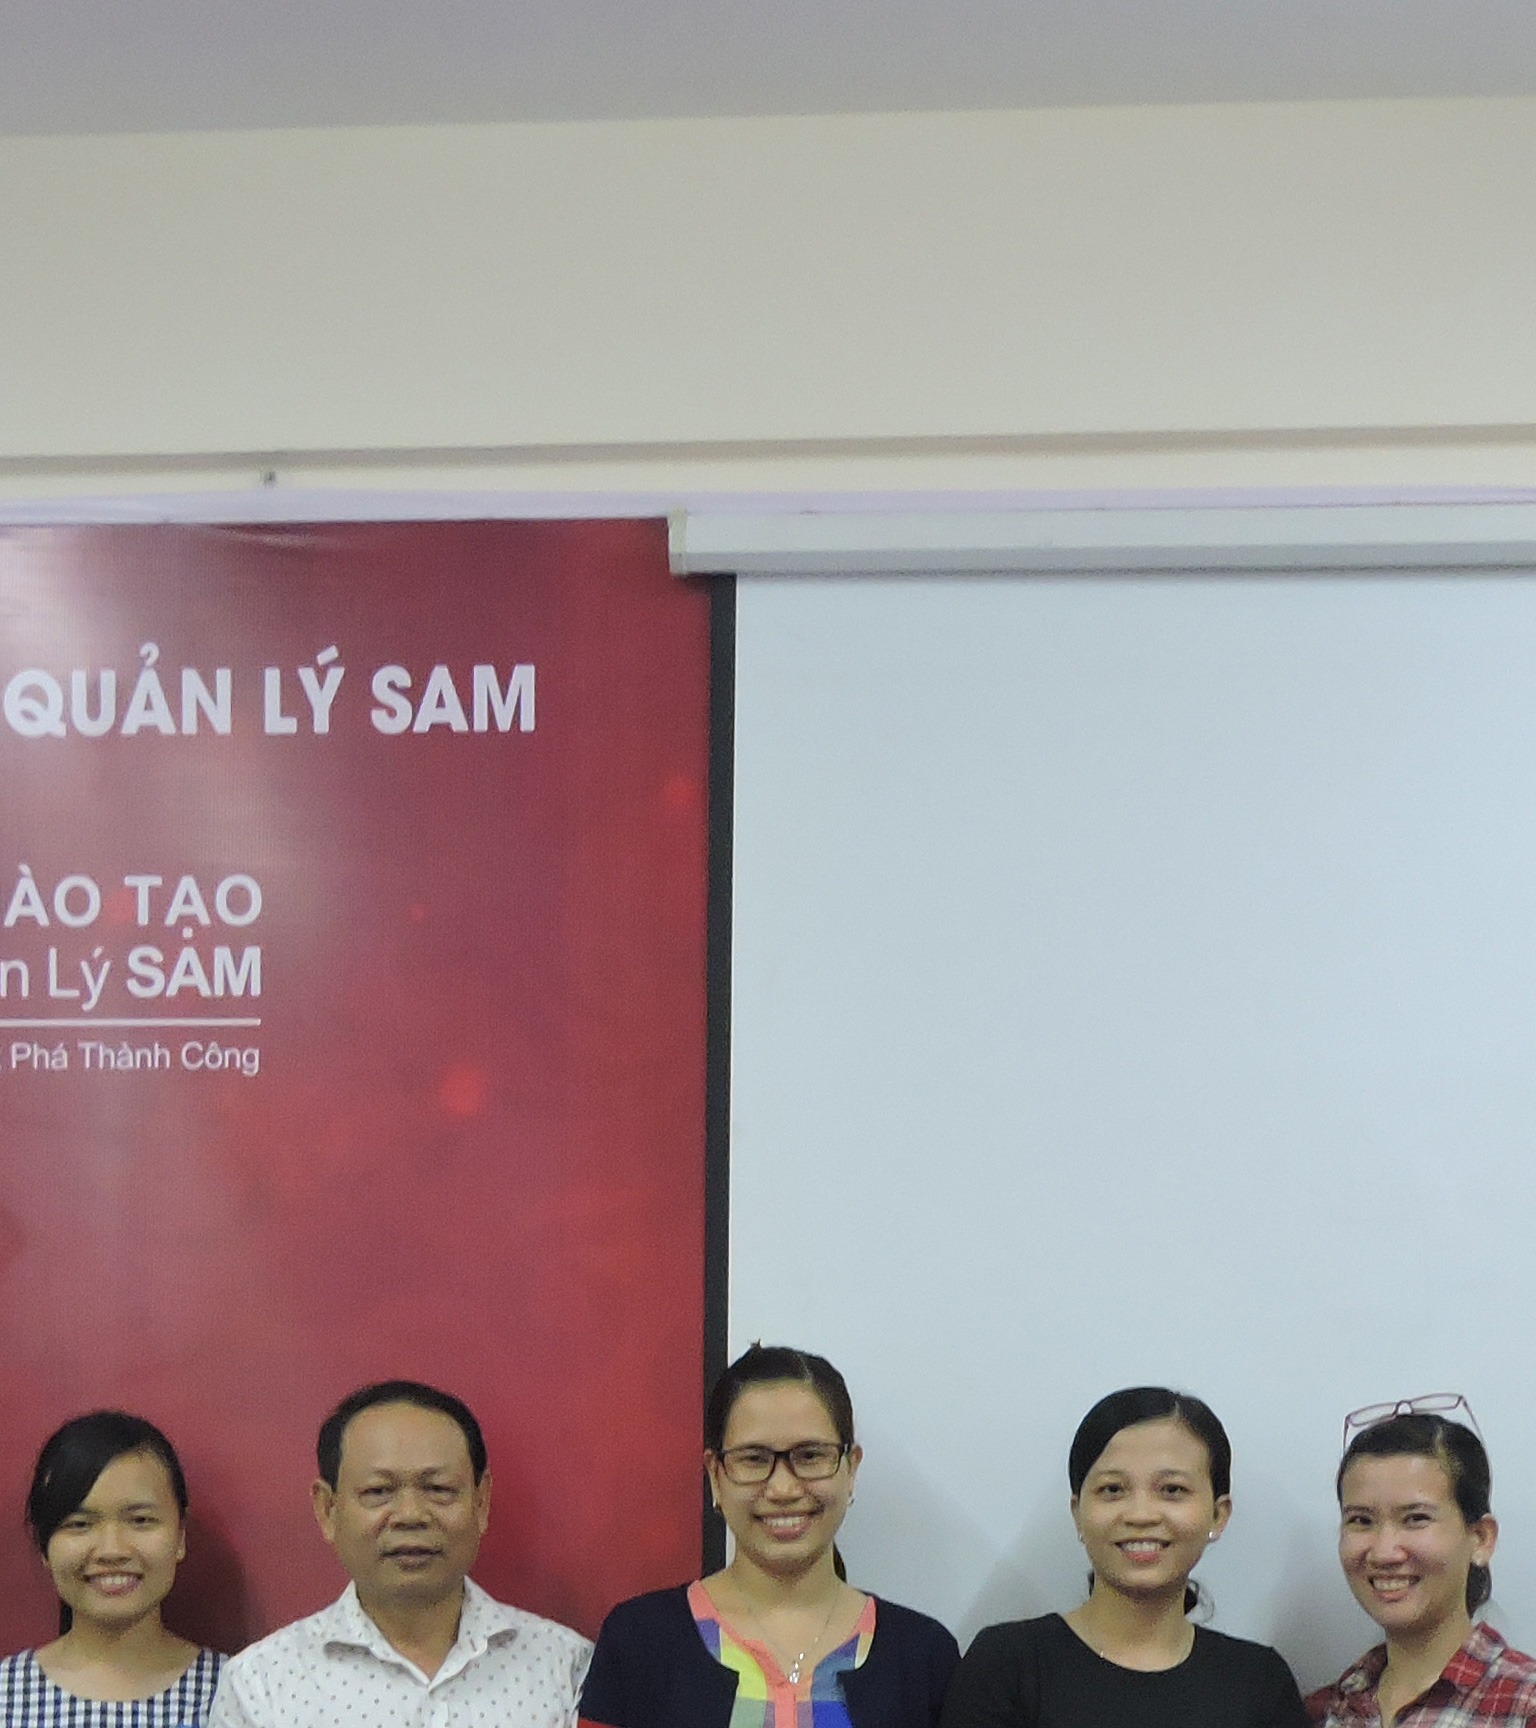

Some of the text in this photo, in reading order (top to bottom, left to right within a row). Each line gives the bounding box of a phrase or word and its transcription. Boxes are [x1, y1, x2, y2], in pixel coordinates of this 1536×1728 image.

[3, 642, 232, 738] QUẢN
[265, 645, 345, 734] LÝ
[370, 664, 536, 735] SAM
[125, 874, 262, 939] TẠO
[49, 945, 111, 1011] Lý
[127, 946, 262, 998] SAM
[11, 1040, 68, 1071] Phá
[77, 1040, 171, 1071] Thành
[181, 1040, 260, 1077] Công
